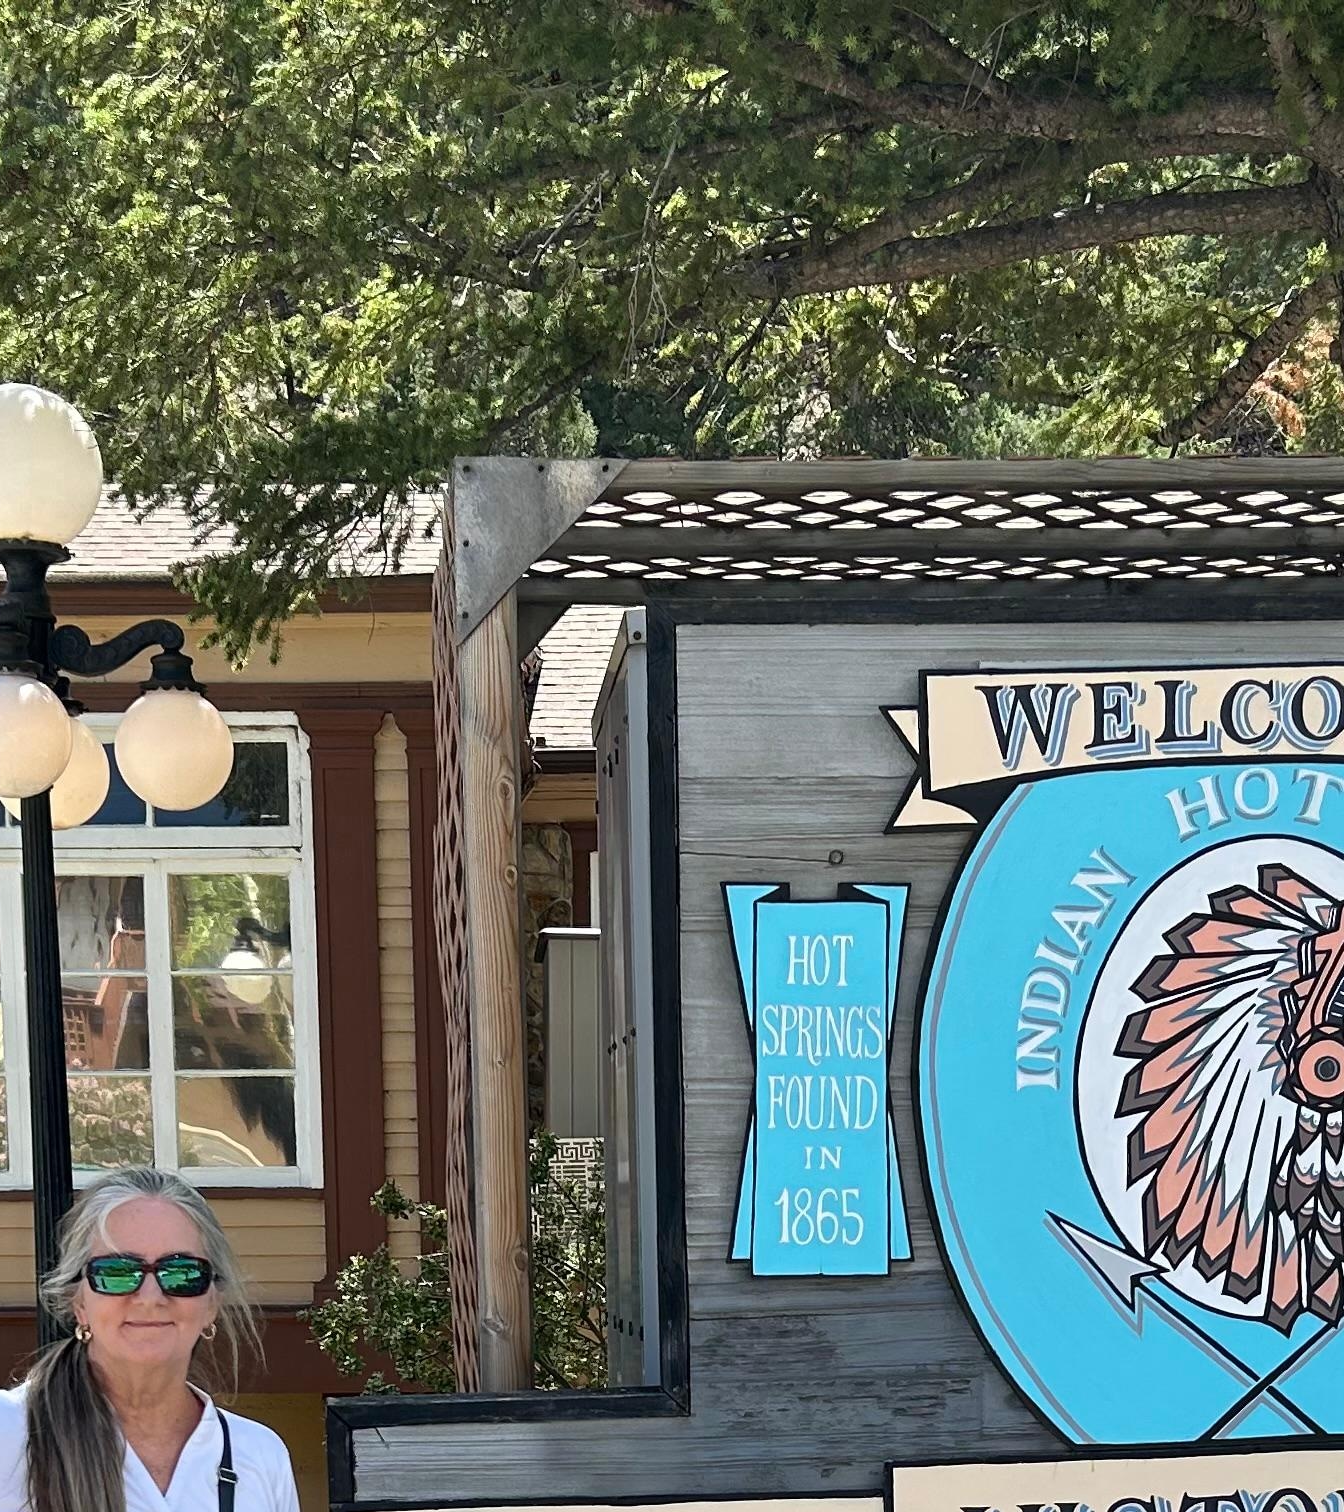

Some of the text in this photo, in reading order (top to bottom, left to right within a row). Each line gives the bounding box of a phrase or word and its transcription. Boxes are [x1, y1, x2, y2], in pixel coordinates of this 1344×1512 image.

[786, 934, 854, 987] HOT
[1015, 845, 1138, 1092] INDIAN
[761, 1004, 884, 1066] SPRINGS
[767, 1075, 879, 1131] FOUND
[804, 1146, 842, 1170] IN
[774, 1187, 865, 1246] 1865
